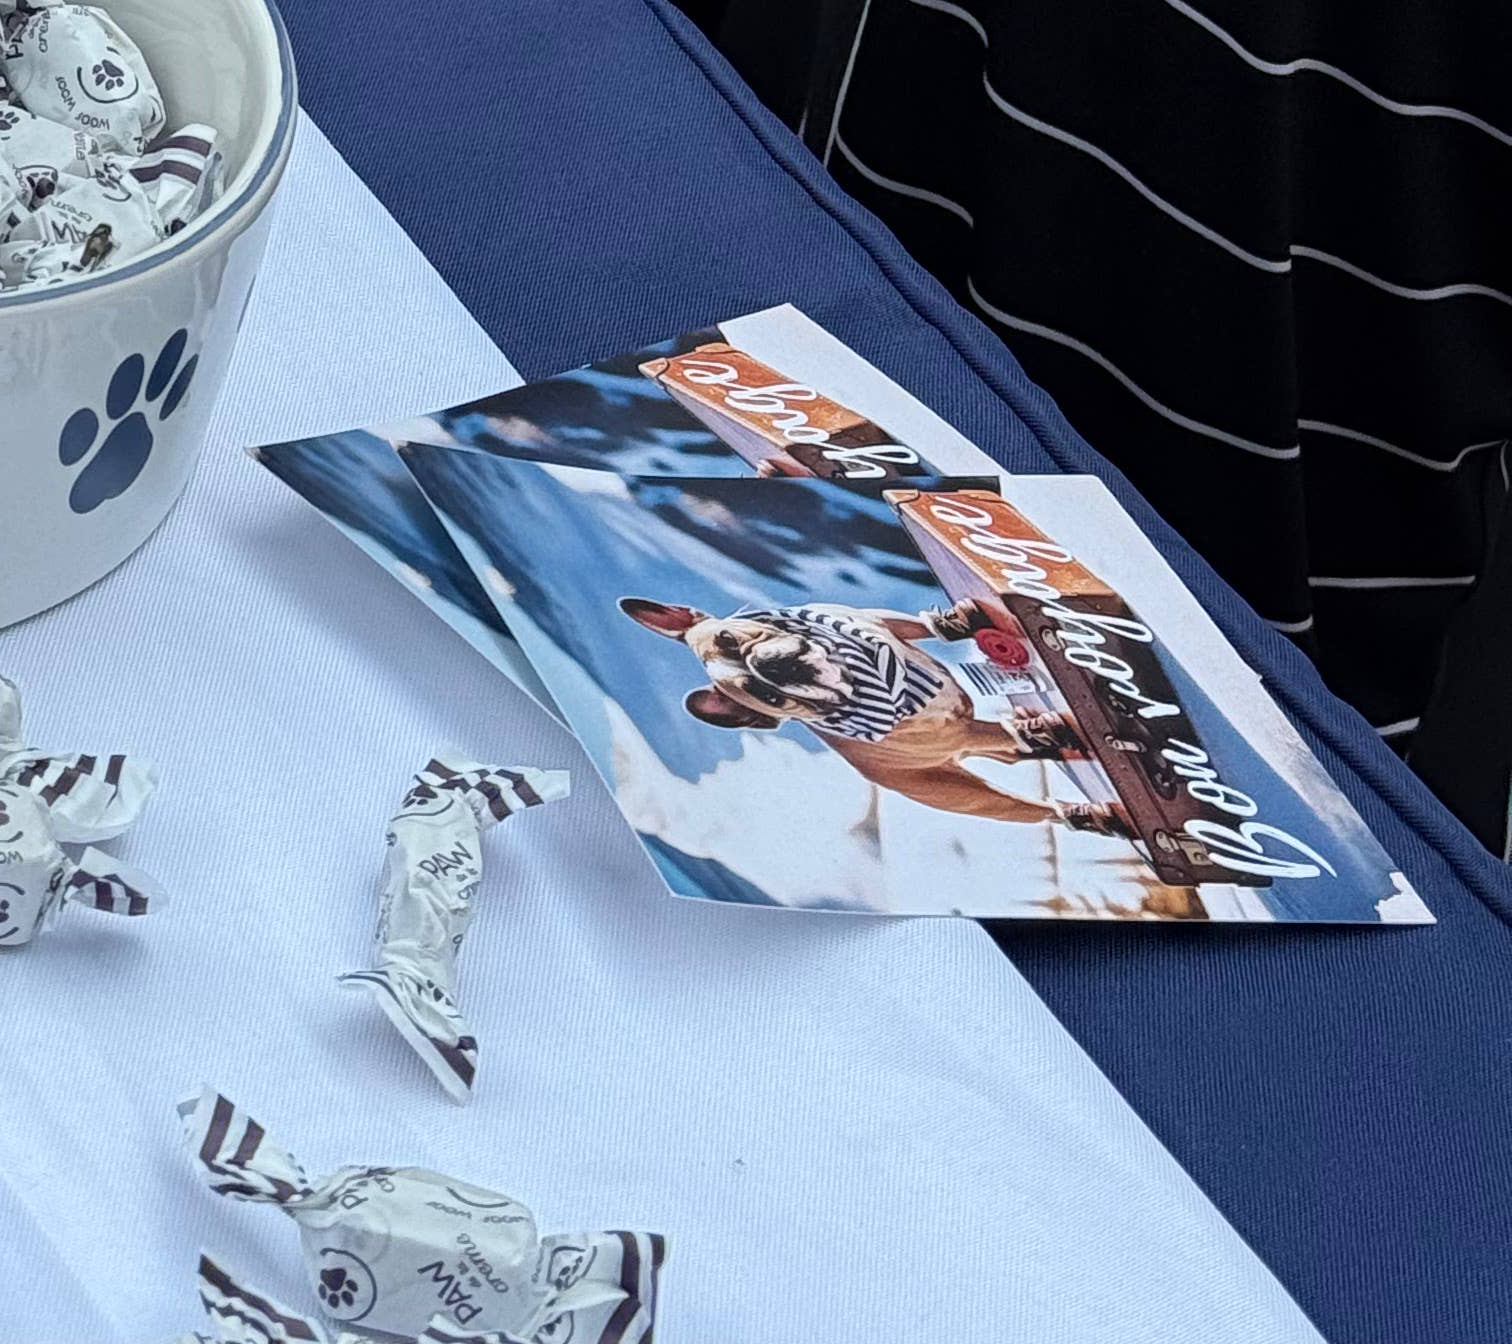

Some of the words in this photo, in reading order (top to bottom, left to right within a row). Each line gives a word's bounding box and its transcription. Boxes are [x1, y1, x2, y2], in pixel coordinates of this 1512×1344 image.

[55, 75, 76, 112] WOOF
[74, 111, 111, 133] WOOF
[929, 495, 1181, 719] voyage
[1160, 737, 1338, 880] Bon
[418, 840, 473, 880] PAW
[417, 1259, 484, 1326] PAW
[455, 1232, 510, 1294] creme
